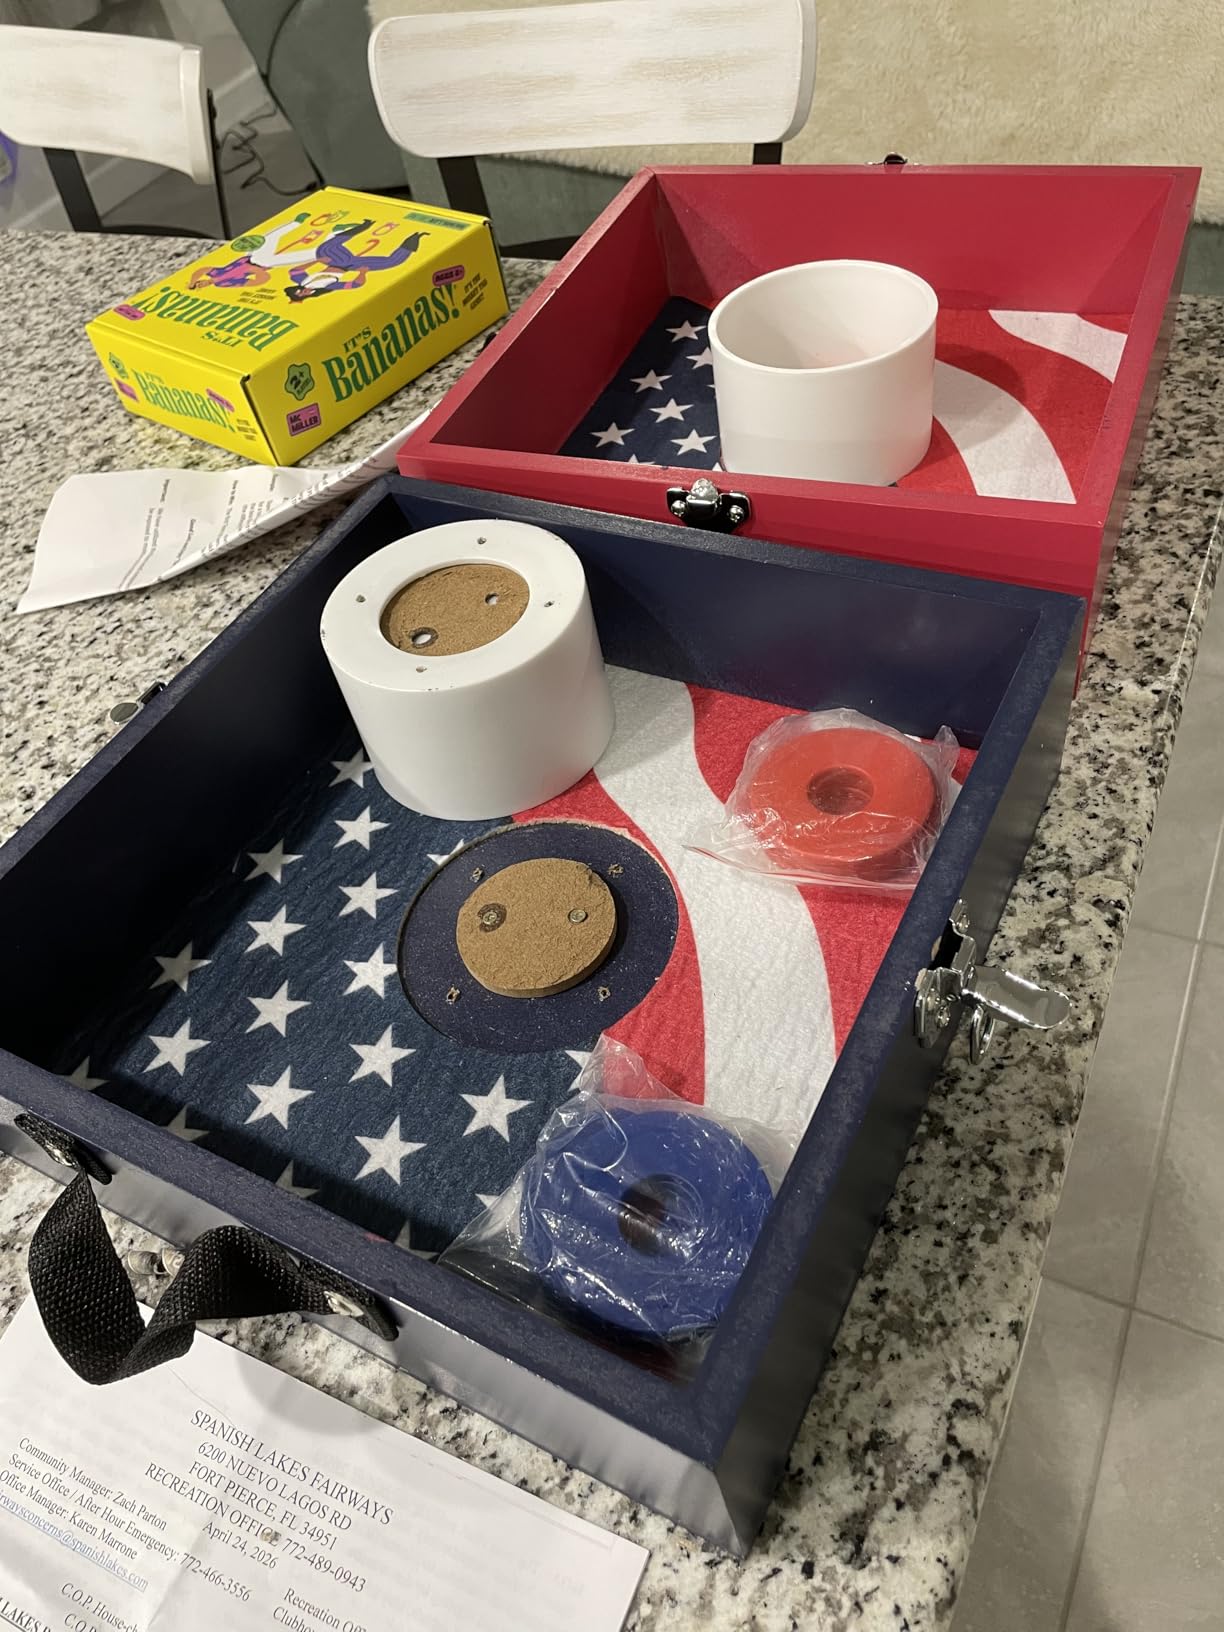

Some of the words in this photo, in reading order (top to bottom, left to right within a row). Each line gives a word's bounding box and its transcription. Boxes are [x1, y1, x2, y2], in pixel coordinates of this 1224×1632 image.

[321, 284, 460, 402] Bananas!
[343, 326, 372, 354] IT'S
[291, 415, 319, 433] MILLER
[19, 1437, 69, 1475] Community
[70, 1466, 113, 1498] Manager:
[112, 1491, 137, 1513] Zach
[138, 1503, 167, 1531] Parton
[188, 1460, 226, 1488] FORT
[225, 1479, 277, 1521] PIERCE,
[280, 1509, 297, 1531] FL
[299, 1521, 338, 1551] 34951
[190, 1409, 255, 1453] SPANISH
[254, 1442, 311, 1482] LAKES
[309, 1471, 394, 1526] FAIRWAYS
[198, 1441, 227, 1464] 6200
[225, 1454, 280, 1492] NUEVO
[278, 1484, 329, 1516] LAGOS
[329, 1509, 352, 1531] RD
[0, 1470, 27, 1493] Office
[26, 1485, 69, 1520] Manager:
[69, 1510, 99, 1537] Karen
[99, 1532, 138, 1561] Marrone
[9, 1453, 41, 1480] Service
[41, 1472, 71, 1498] Office
[75, 1492, 101, 1515] After
[100, 1506, 125, 1528] Hour
[124, 1520, 179, 1562] Emergency:
[179, 1552, 253, 1602] 772-466-3556
[144, 1462, 231, 1518] RECREATION
[229, 1508, 282, 1547] OFFICE
[281, 1538, 367, 1593] 772-489-0943
[202, 1521, 232, 1545] April
[231, 1535, 248, 1557] 24,
[249, 1549, 279, 1569] 2026
[61, 1582, 93, 1611] C.O.P.
[93, 1602, 140, 1632] House-ch
[273, 1606, 315, 1632] Clubho
[283, 1587, 341, 1629] Recreation
